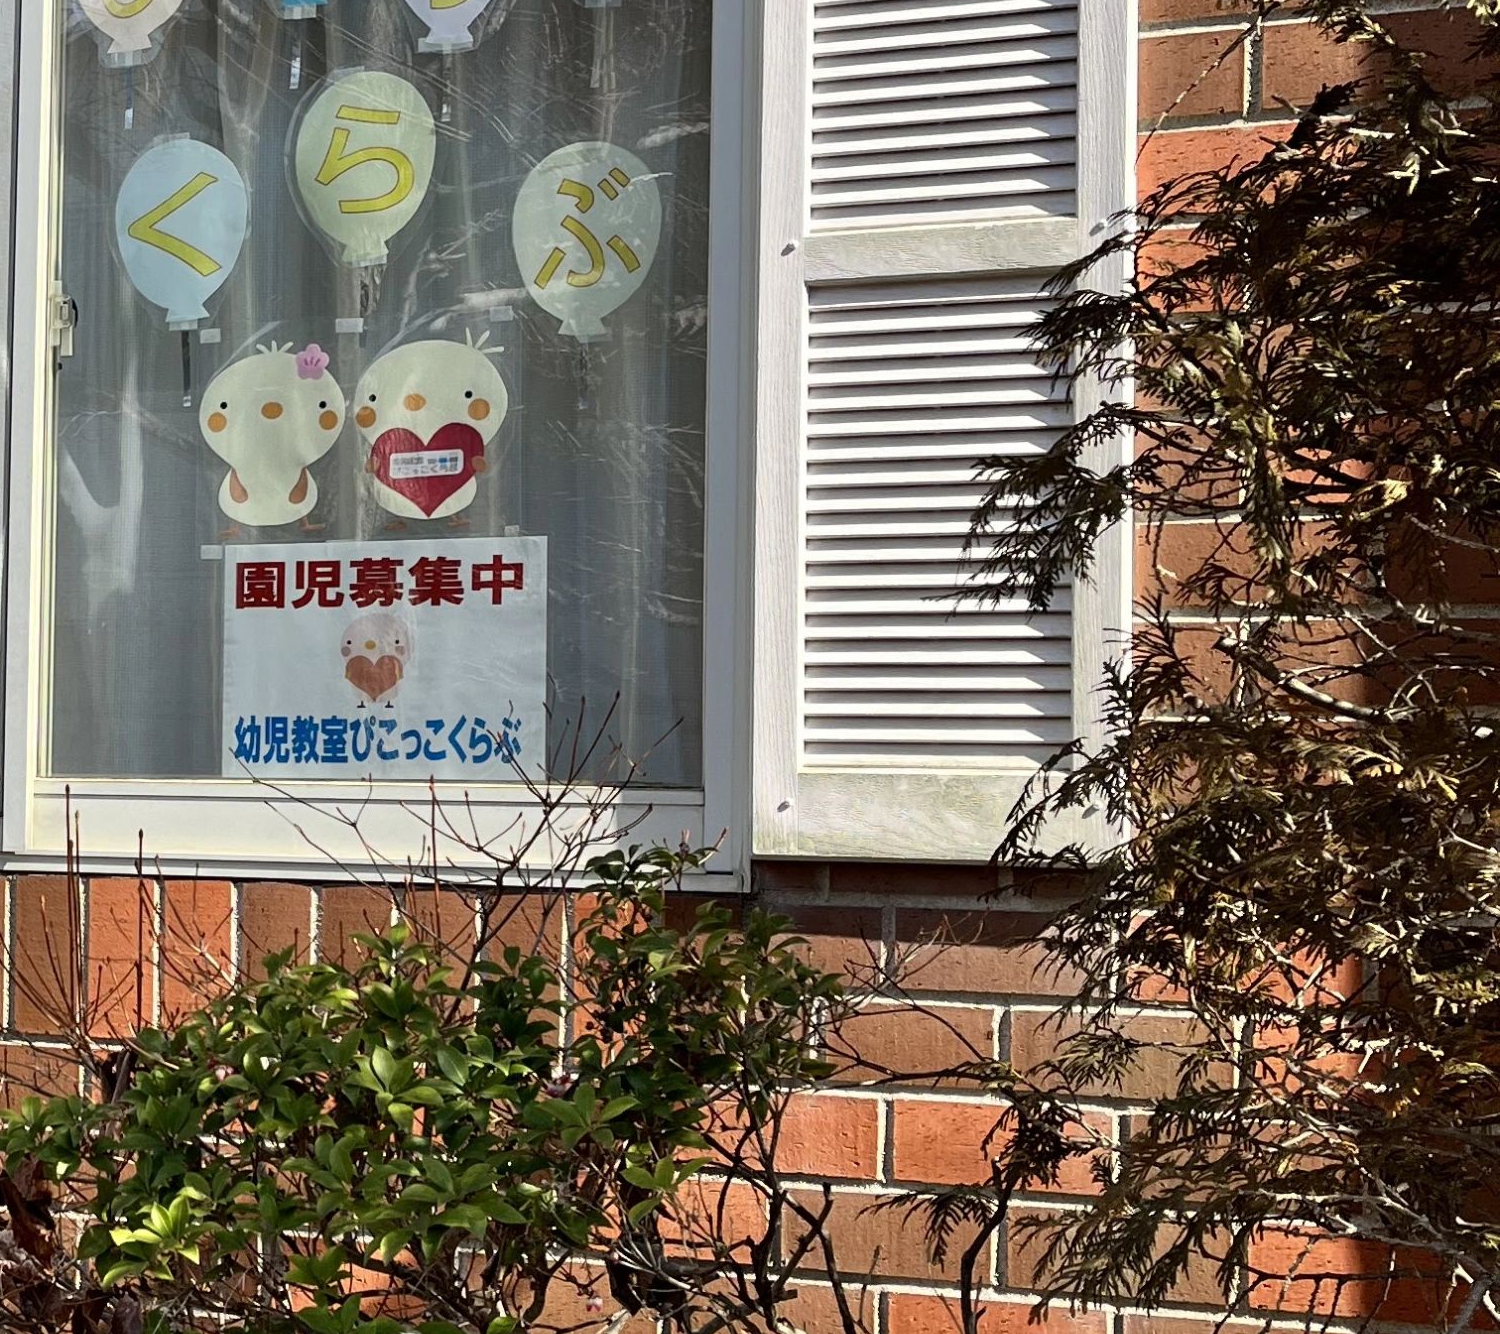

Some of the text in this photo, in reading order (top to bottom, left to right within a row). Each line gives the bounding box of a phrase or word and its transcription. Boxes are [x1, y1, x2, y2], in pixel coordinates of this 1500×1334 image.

[234, 554, 525, 610] 園児募集中
[234, 714, 524, 765] 幼児教室ぴこっこくらぶ
